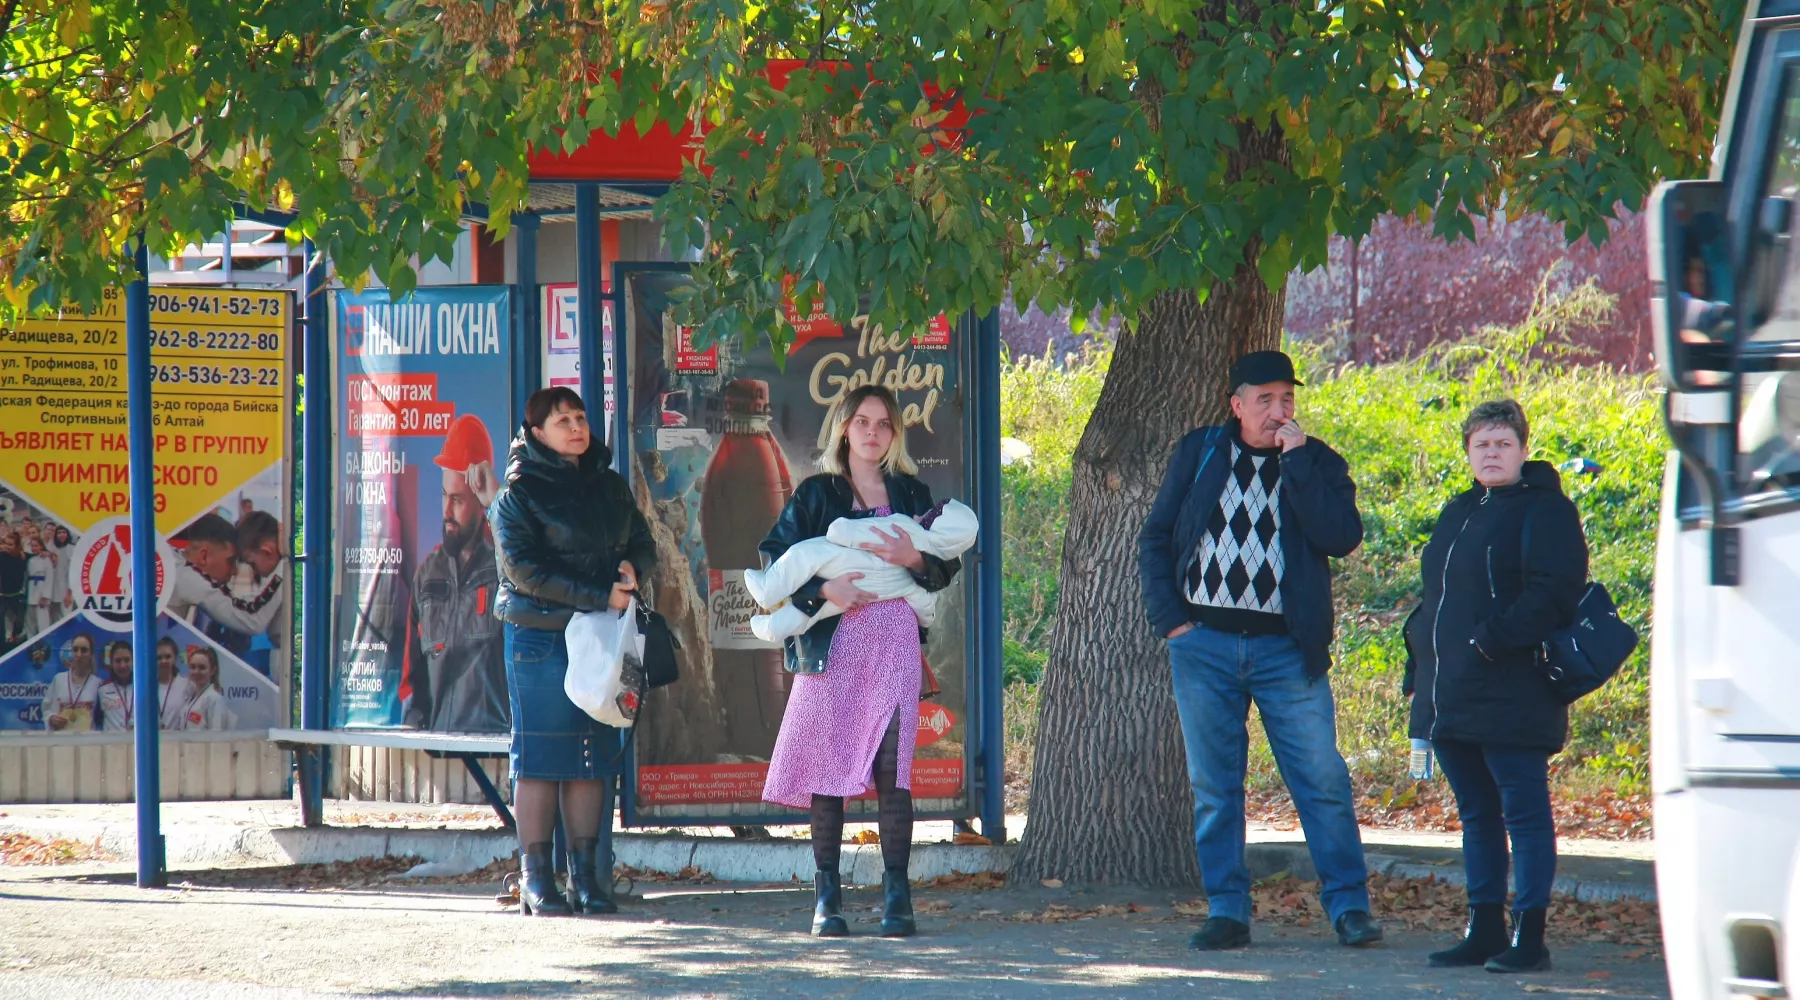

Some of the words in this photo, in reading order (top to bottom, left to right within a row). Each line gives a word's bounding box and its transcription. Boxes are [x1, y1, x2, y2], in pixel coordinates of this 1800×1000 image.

[83, 327, 118, 345] 20/2
[368, 302, 431, 355] НАШИ
[437, 302, 500, 355] ОКНА
[851, 314, 909, 359] The
[1, 358, 20, 371] ул.
[24, 356, 98, 372] Трофимова,
[103, 358, 118, 370] 10
[0, 376, 19, 387] ул.
[22, 374, 86, 388] Радищева,
[89, 374, 118, 388] 20/2
[808, 352, 945, 406] Golden
[376, 384, 432, 402] монтаж
[36, 396, 112, 410] Федерация
[185, 401, 229, 416] города
[233, 400, 279, 413] Бийска
[40, 411, 126, 426] Спортивный
[165, 412, 205, 427] Алтай
[348, 409, 397, 435] Гарантия
[400, 408, 419, 430] 30
[423, 413, 451, 430] лет
[101, 433, 168, 453] НАР
[175, 436, 187, 453] В
[193, 435, 269, 455] ГРУППУ
[345, 451, 405, 475] БАЛКОНЫ
[25, 462, 218, 486] ОЛИМПИСКОГО
[345, 482, 353, 505] И
[356, 482, 387, 505] ОКНА
[724, 580, 746, 597] The
[712, 595, 759, 615] Golden
[228, 686, 259, 701] (WKF)
[341, 678, 382, 692] ТРЕТЬЯКОВ
[641, 773, 661, 782] ООО
[707, 789, 729, 799] ОГРН
